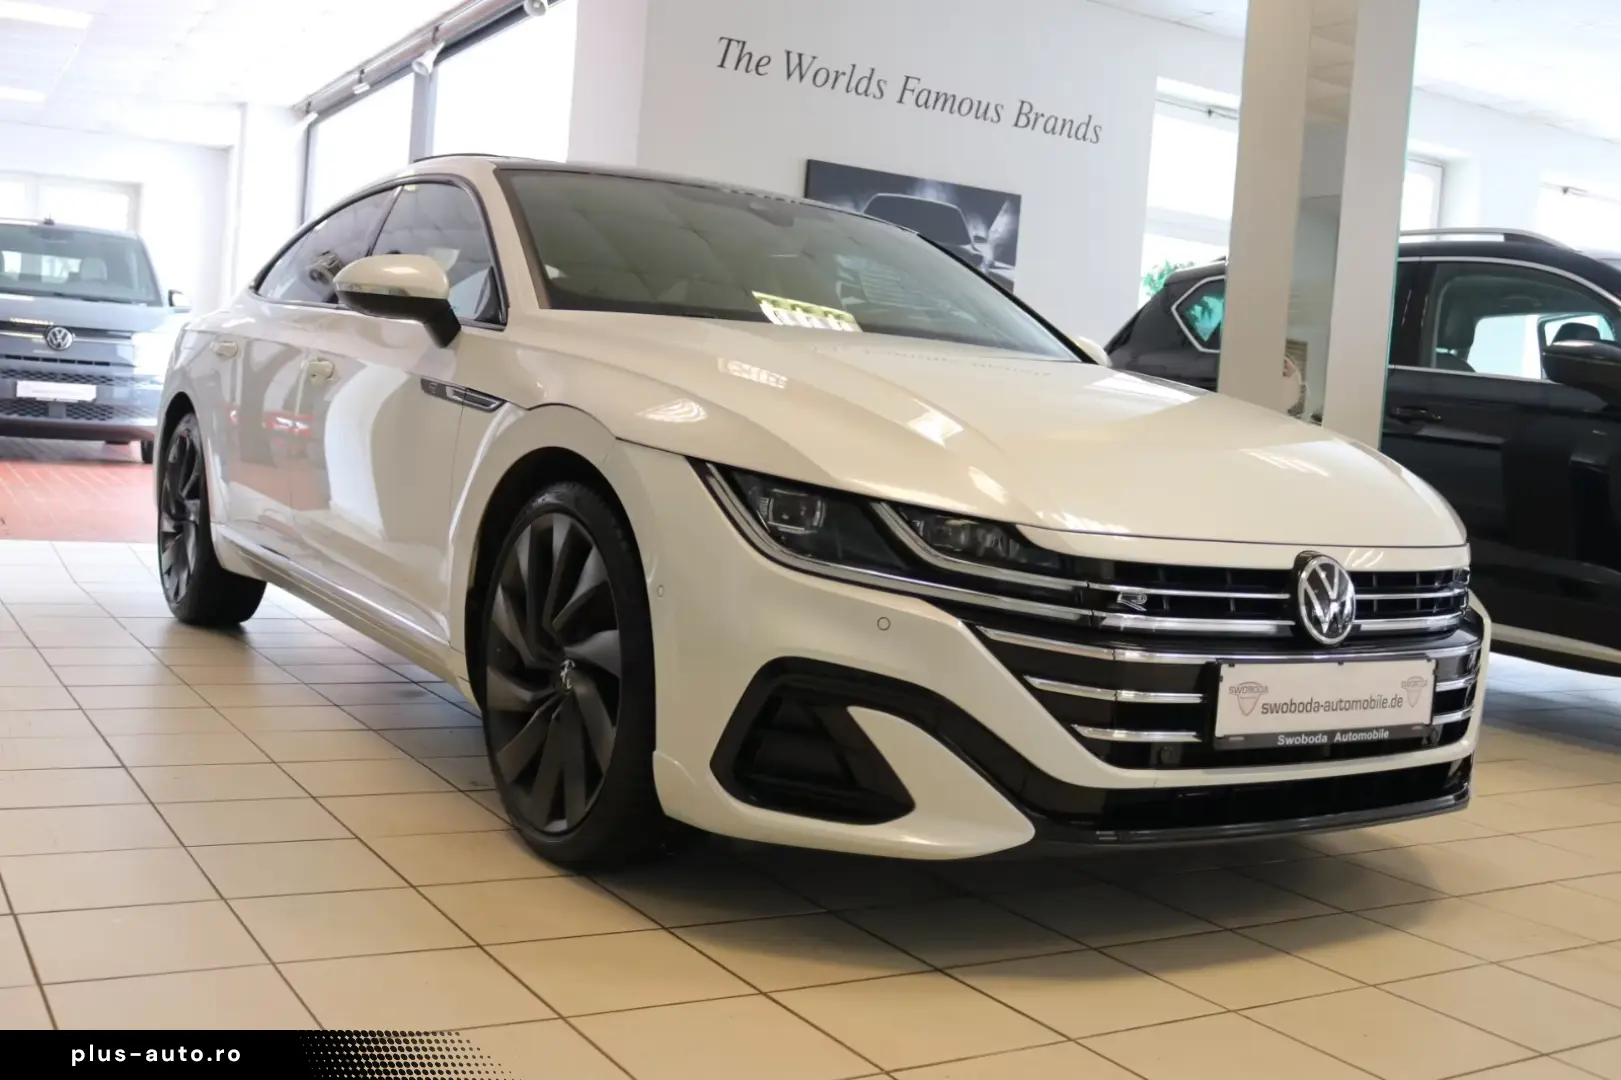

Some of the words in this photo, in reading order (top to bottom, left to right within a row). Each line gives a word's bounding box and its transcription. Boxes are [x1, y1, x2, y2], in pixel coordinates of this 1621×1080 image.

[716, 37, 771, 76] The
[784, 49, 888, 100] Worlds
[896, 75, 1004, 124] Famous
[1011, 99, 1103, 145] Brands
[1260, 694, 1403, 715] swoboda-automobile.de
[1277, 734, 1328, 746] Swoboda
[1334, 728, 1389, 743] Automobile
